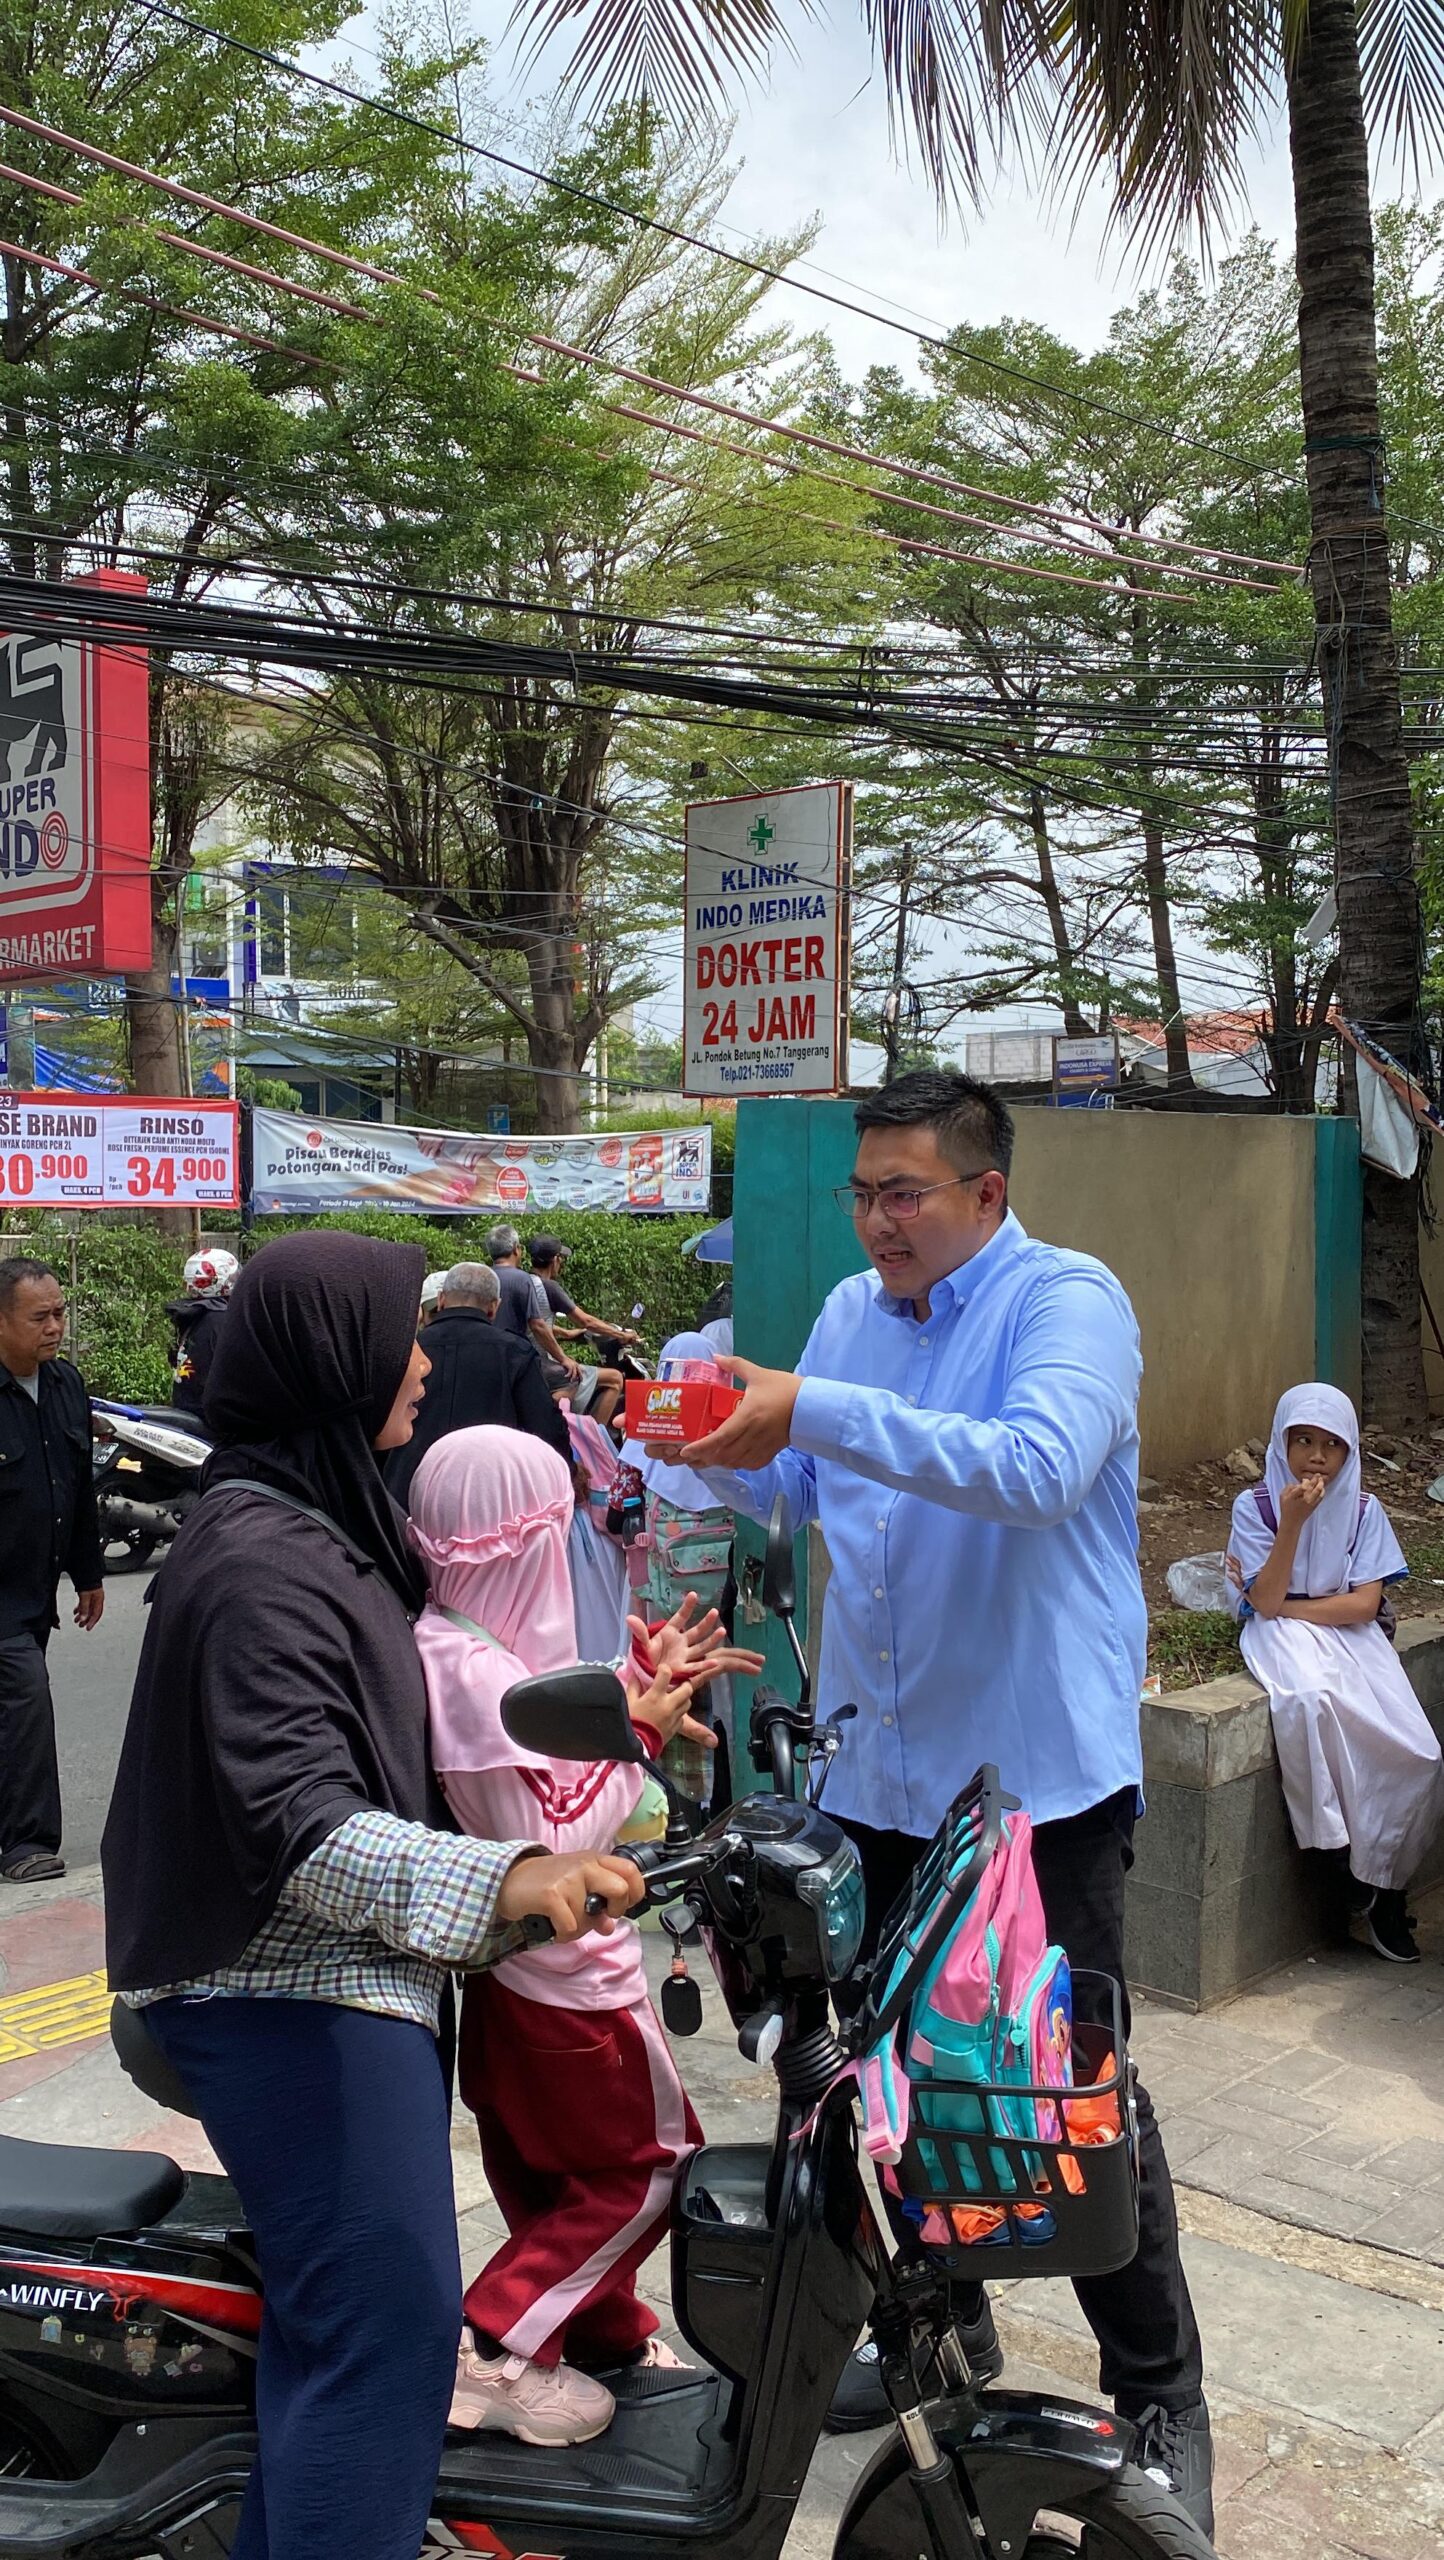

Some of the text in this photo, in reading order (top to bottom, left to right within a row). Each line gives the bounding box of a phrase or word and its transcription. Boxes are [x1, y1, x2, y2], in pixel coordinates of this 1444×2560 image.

[721, 862, 800, 892] KLINIK
[696, 894, 827, 930] INDO MEDIKA
[696, 935, 826, 990] DOKTER
[702, 994, 816, 1046] 24 JAM
[691, 1045, 830, 1064] JL. Pondok Betung No.7 Tanggerang
[27, 1113, 97, 1137] BRAND
[140, 1116, 204, 1135] RINSO
[21, 1139, 48, 1150] GORENG
[49, 1141, 63, 1150] PCH
[64, 1141, 72, 1151] 2L
[286, 1147, 391, 1161] Pisau Berkelas
[0, 1153, 88, 1196] 0.900
[127, 1156, 226, 1197] 34.900
[267, 1160, 408, 1176] Potongan Jadi Pas!
[676, 1168, 699, 1178] INDO
[11, 2283, 105, 2312] WINFLY
